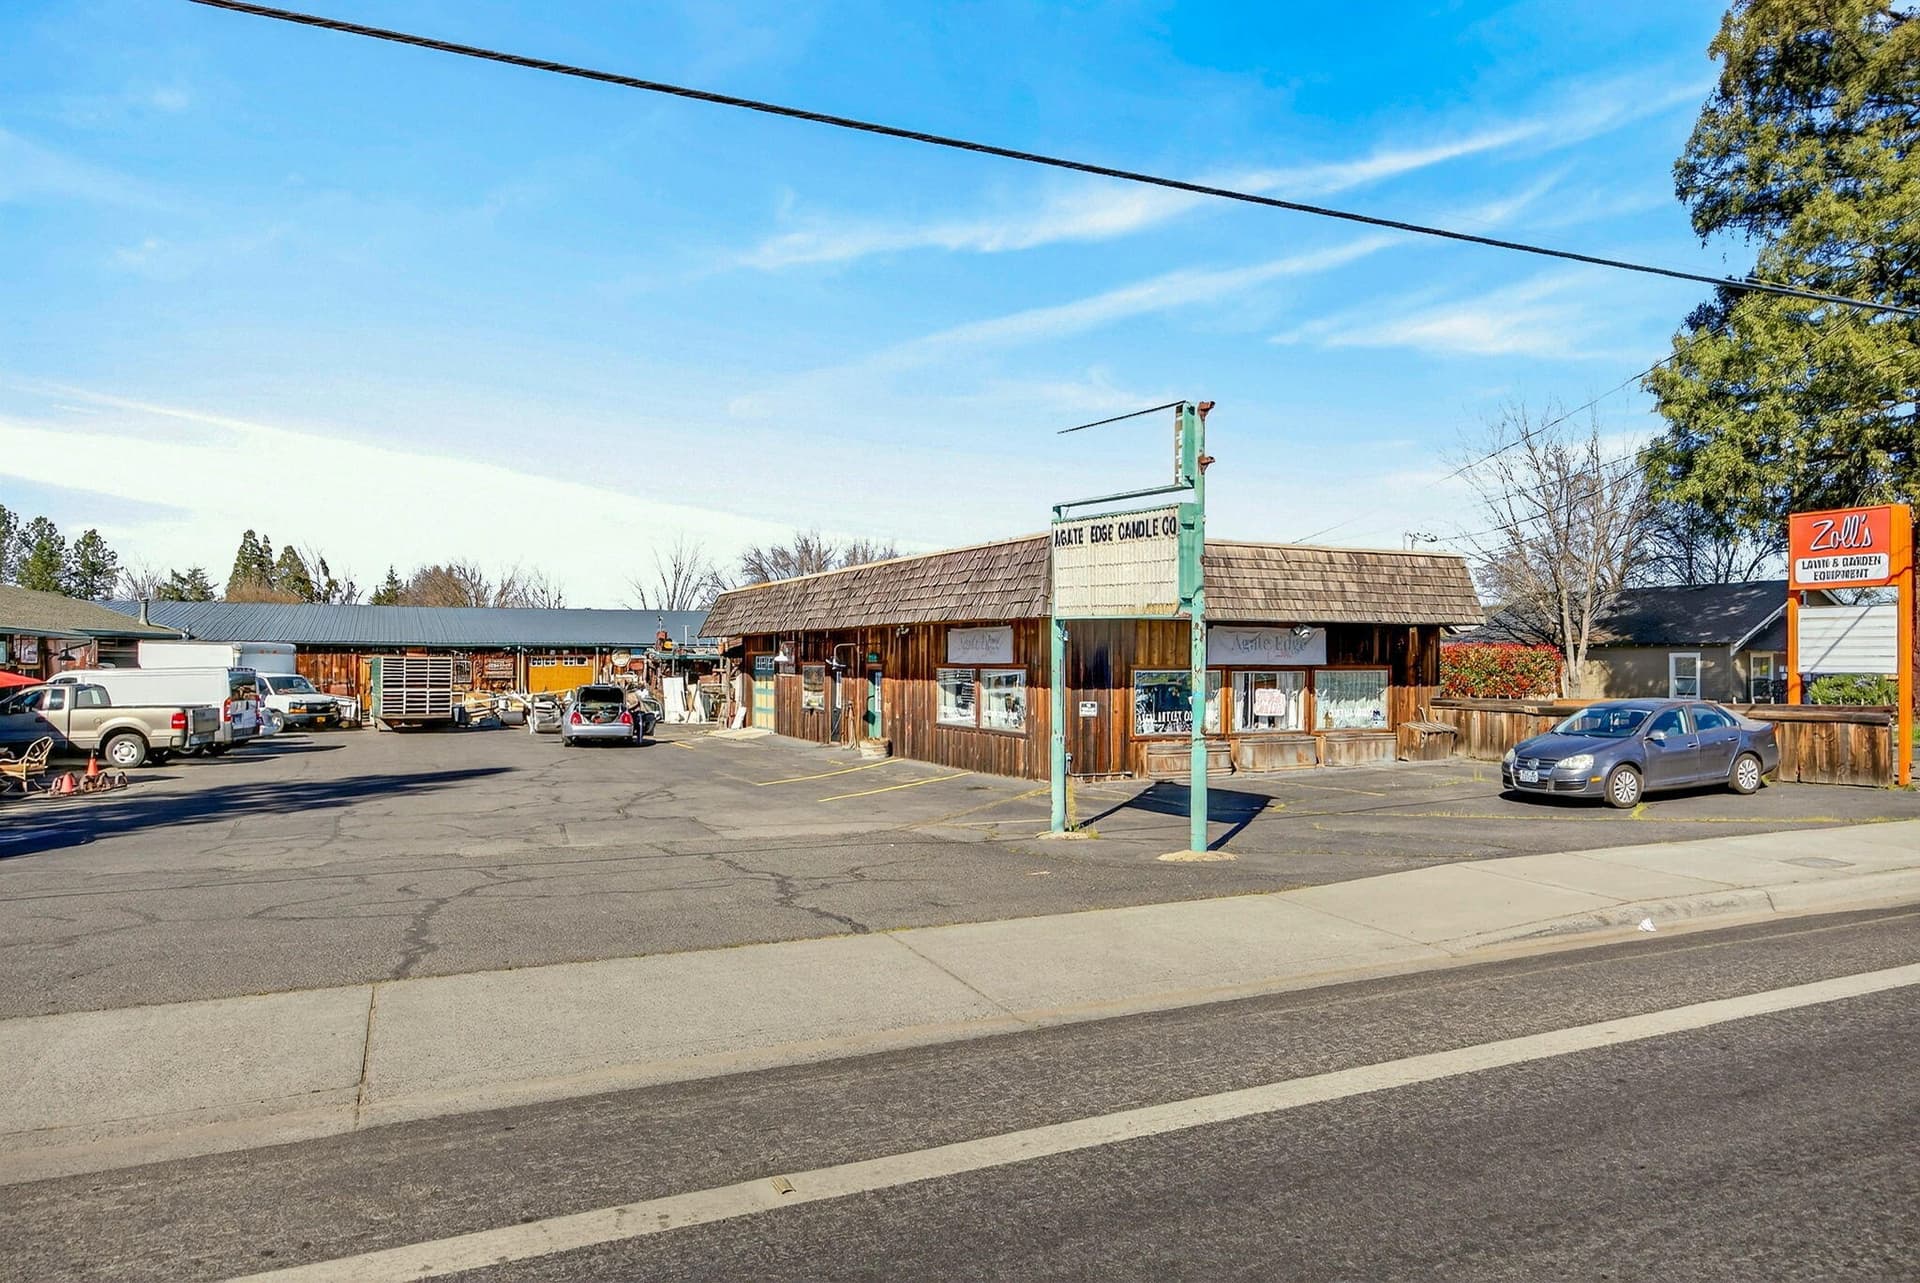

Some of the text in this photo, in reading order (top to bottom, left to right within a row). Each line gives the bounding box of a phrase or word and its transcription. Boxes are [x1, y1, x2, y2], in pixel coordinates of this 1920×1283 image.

[1054, 526, 1084, 547] AGATE
[1090, 524, 1114, 544] EDGE
[1118, 518, 1159, 541] CANDLE
[1810, 514, 1873, 551] Zoll's
[1802, 558, 1830, 570] LAWN
[1842, 555, 1881, 568] GARDEN
[1813, 568, 1869, 581] EQUIPMENT
